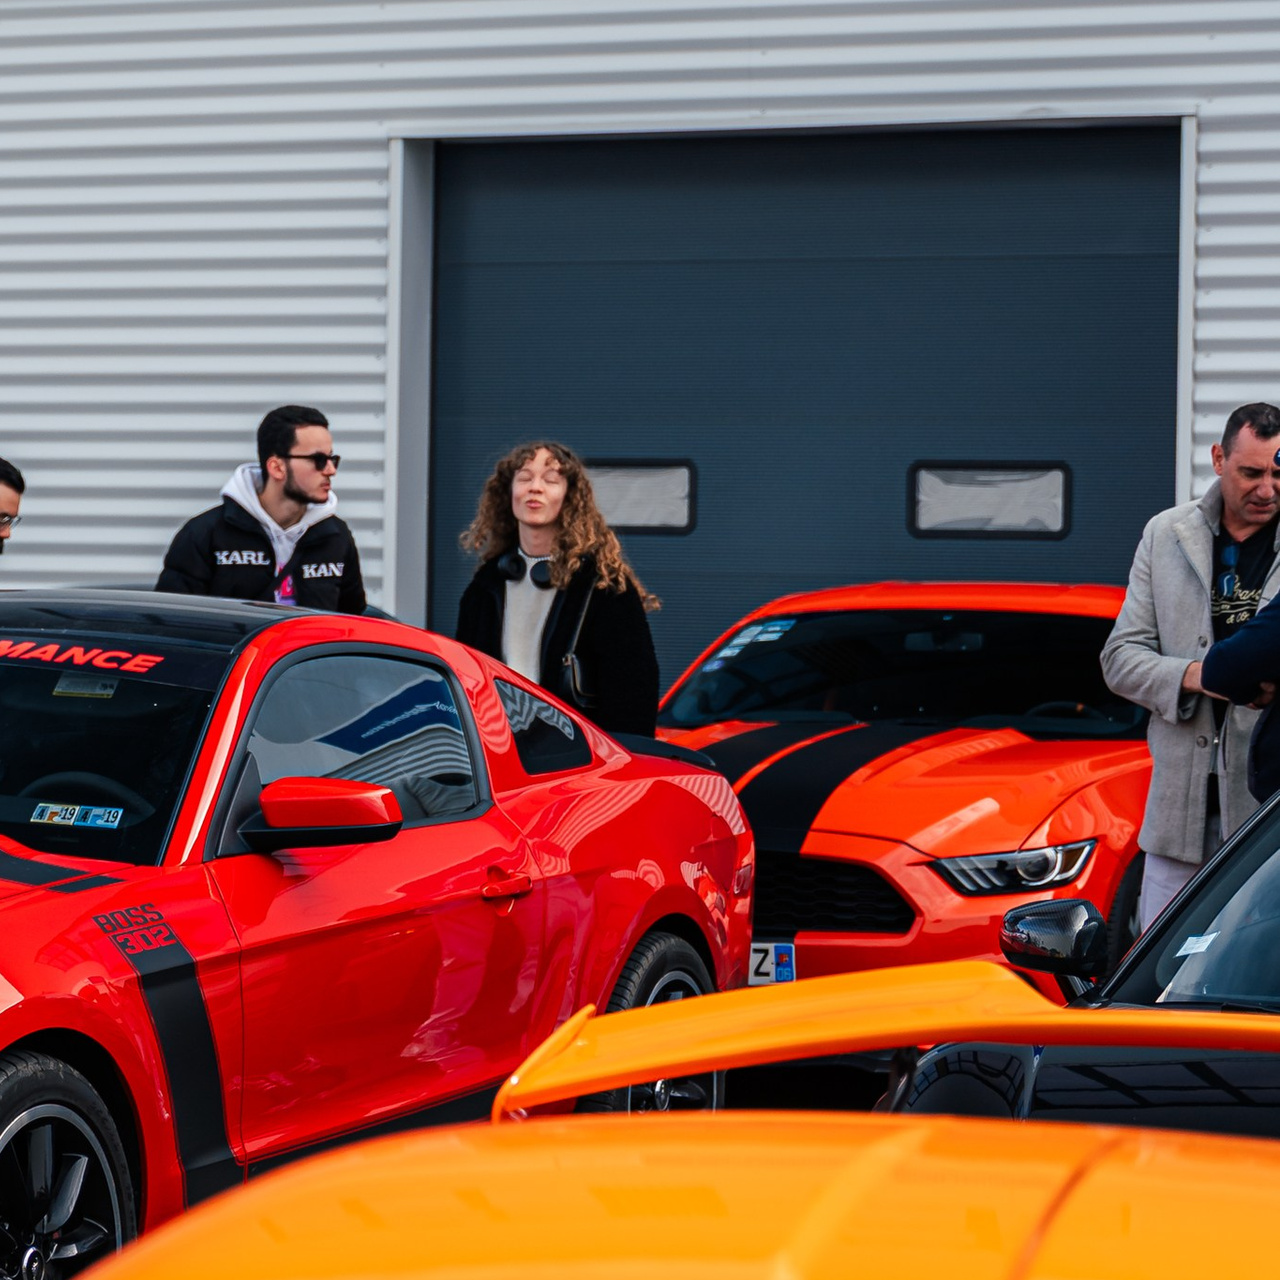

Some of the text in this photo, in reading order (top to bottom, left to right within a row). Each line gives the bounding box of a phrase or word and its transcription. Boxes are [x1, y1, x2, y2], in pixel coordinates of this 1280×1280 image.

[214, 550, 270, 566] KARL
[60, 806, 77, 821] 19
[103, 809, 120, 824] 19
[92, 902, 164, 934] BOSS
[116, 924, 177, 955] 302
